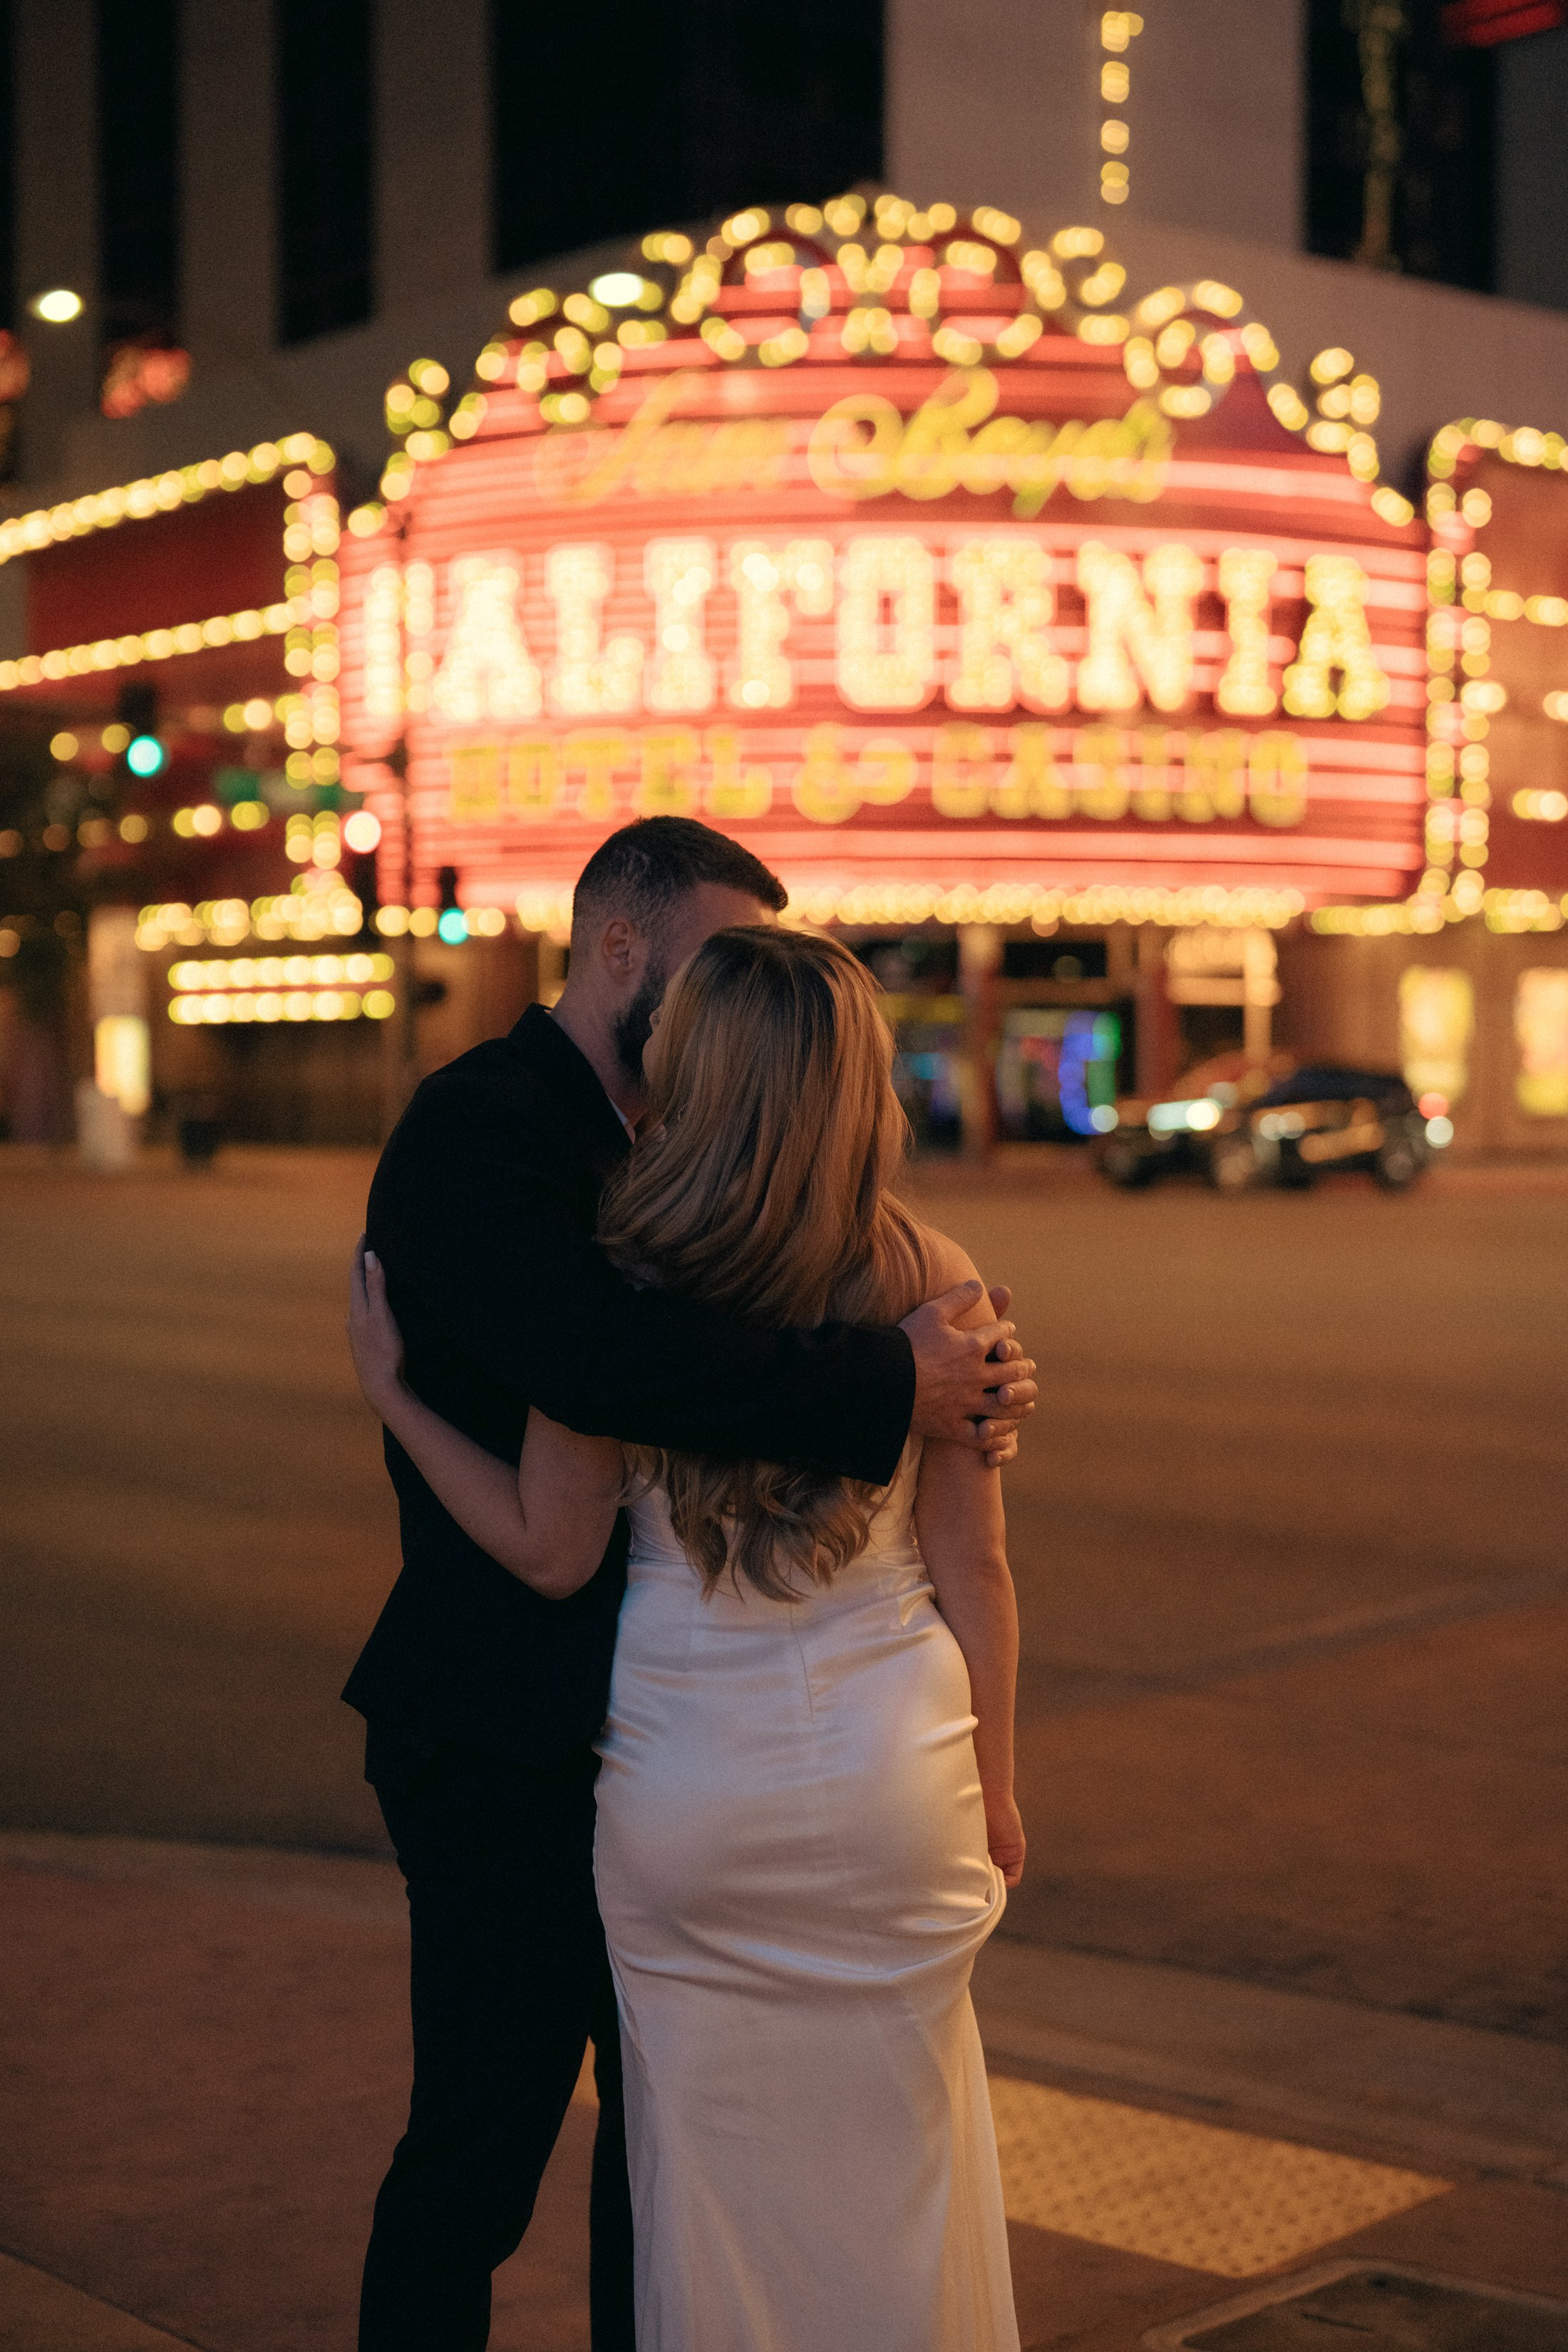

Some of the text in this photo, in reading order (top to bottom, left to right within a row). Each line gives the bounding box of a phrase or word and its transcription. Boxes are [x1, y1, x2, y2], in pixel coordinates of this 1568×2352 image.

[445, 721, 1309, 827] HOTEL & CASINO
